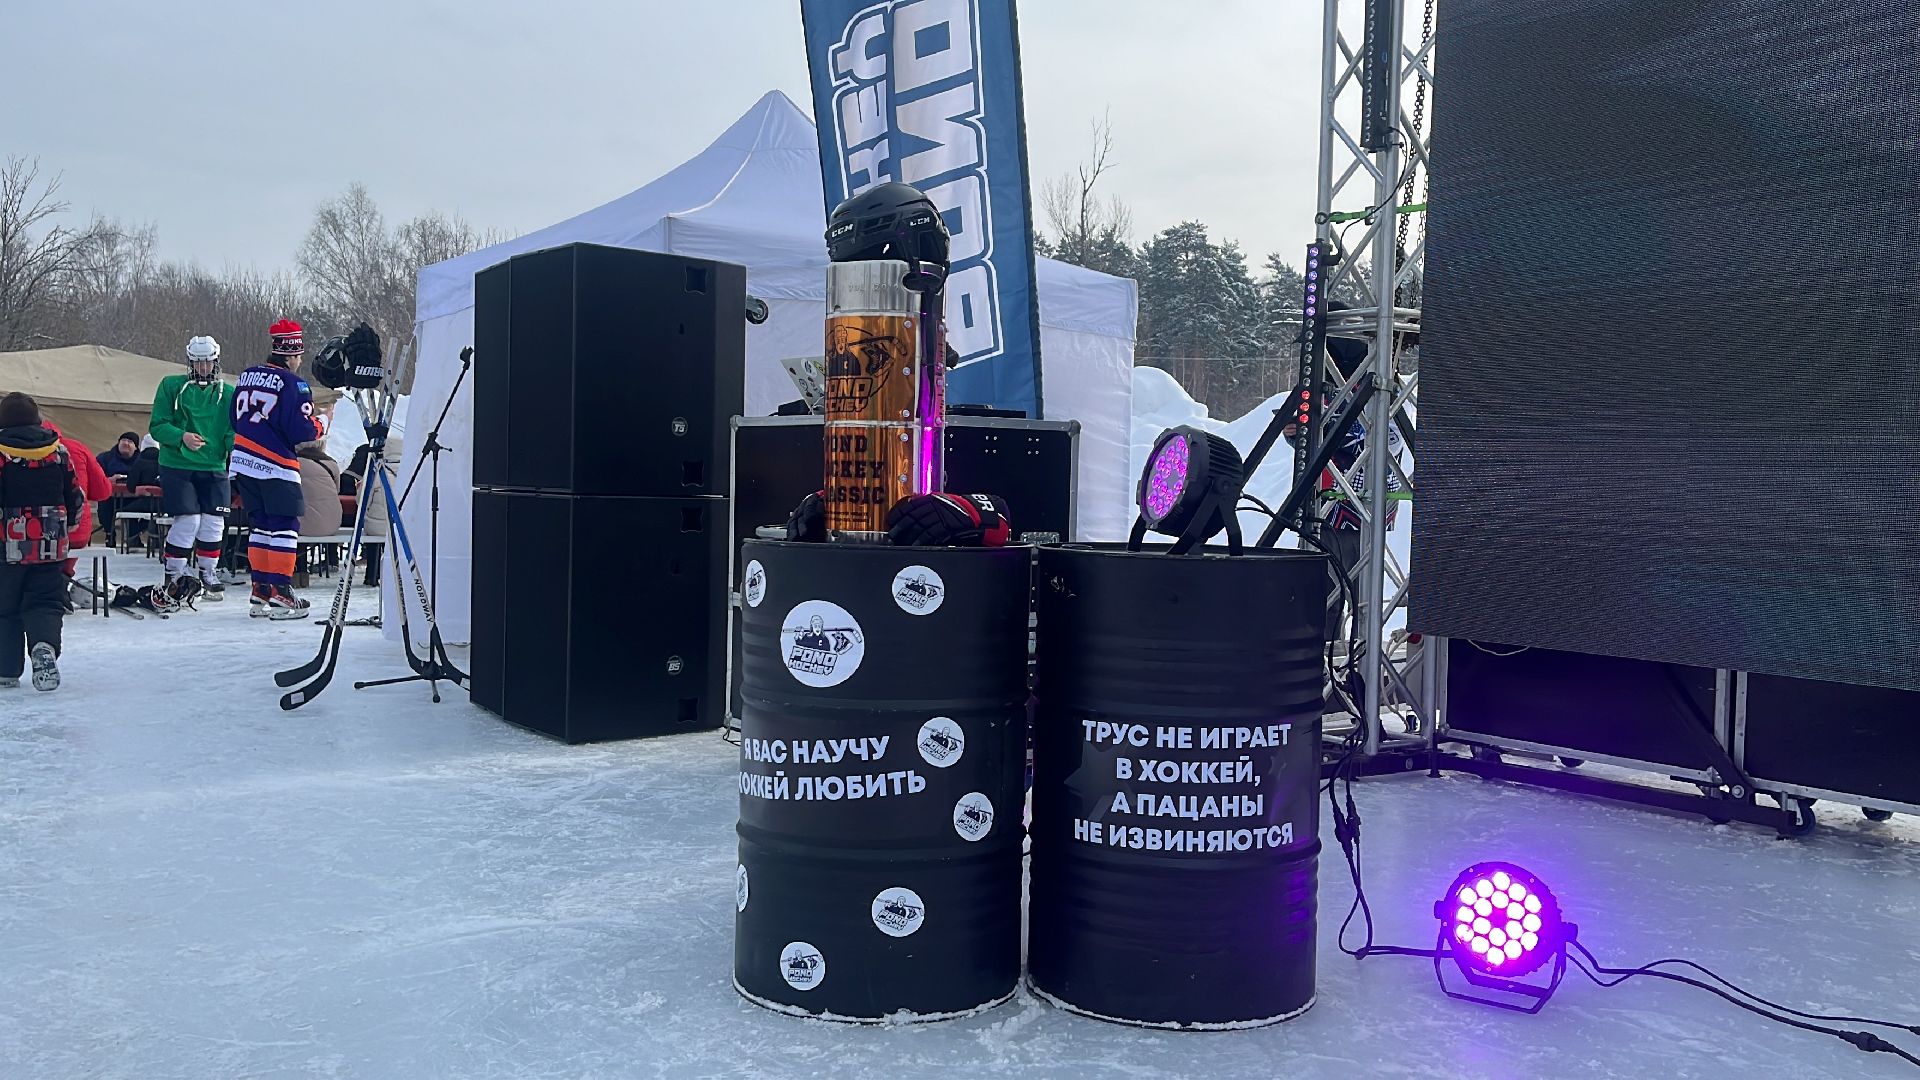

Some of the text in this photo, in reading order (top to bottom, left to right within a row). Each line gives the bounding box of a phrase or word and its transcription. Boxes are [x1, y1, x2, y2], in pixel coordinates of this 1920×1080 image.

[831, 222, 854, 238] CCM
[329, 576, 345, 621] NORDWAY
[341, 574, 352, 622] NORDWAY
[414, 578, 434, 623] NORDWAY
[788, 659, 833, 675] HOCKEY
[790, 646, 838, 667] POND
[1083, 720, 1292, 749] ТРУС НЕ ИГРАЕТ
[744, 736, 890, 764] Я ВАС НАУЧУ
[795, 770, 926, 801] ЛЮБИТЬ
[1117, 756, 1261, 787] В ХОККЕЙ,
[1111, 792, 1264, 821] А ПАЦАНЫ
[1075, 819, 1293, 852] НЕ ИЗВИНЯЮТСЯ
[788, 968, 813, 977] POND
